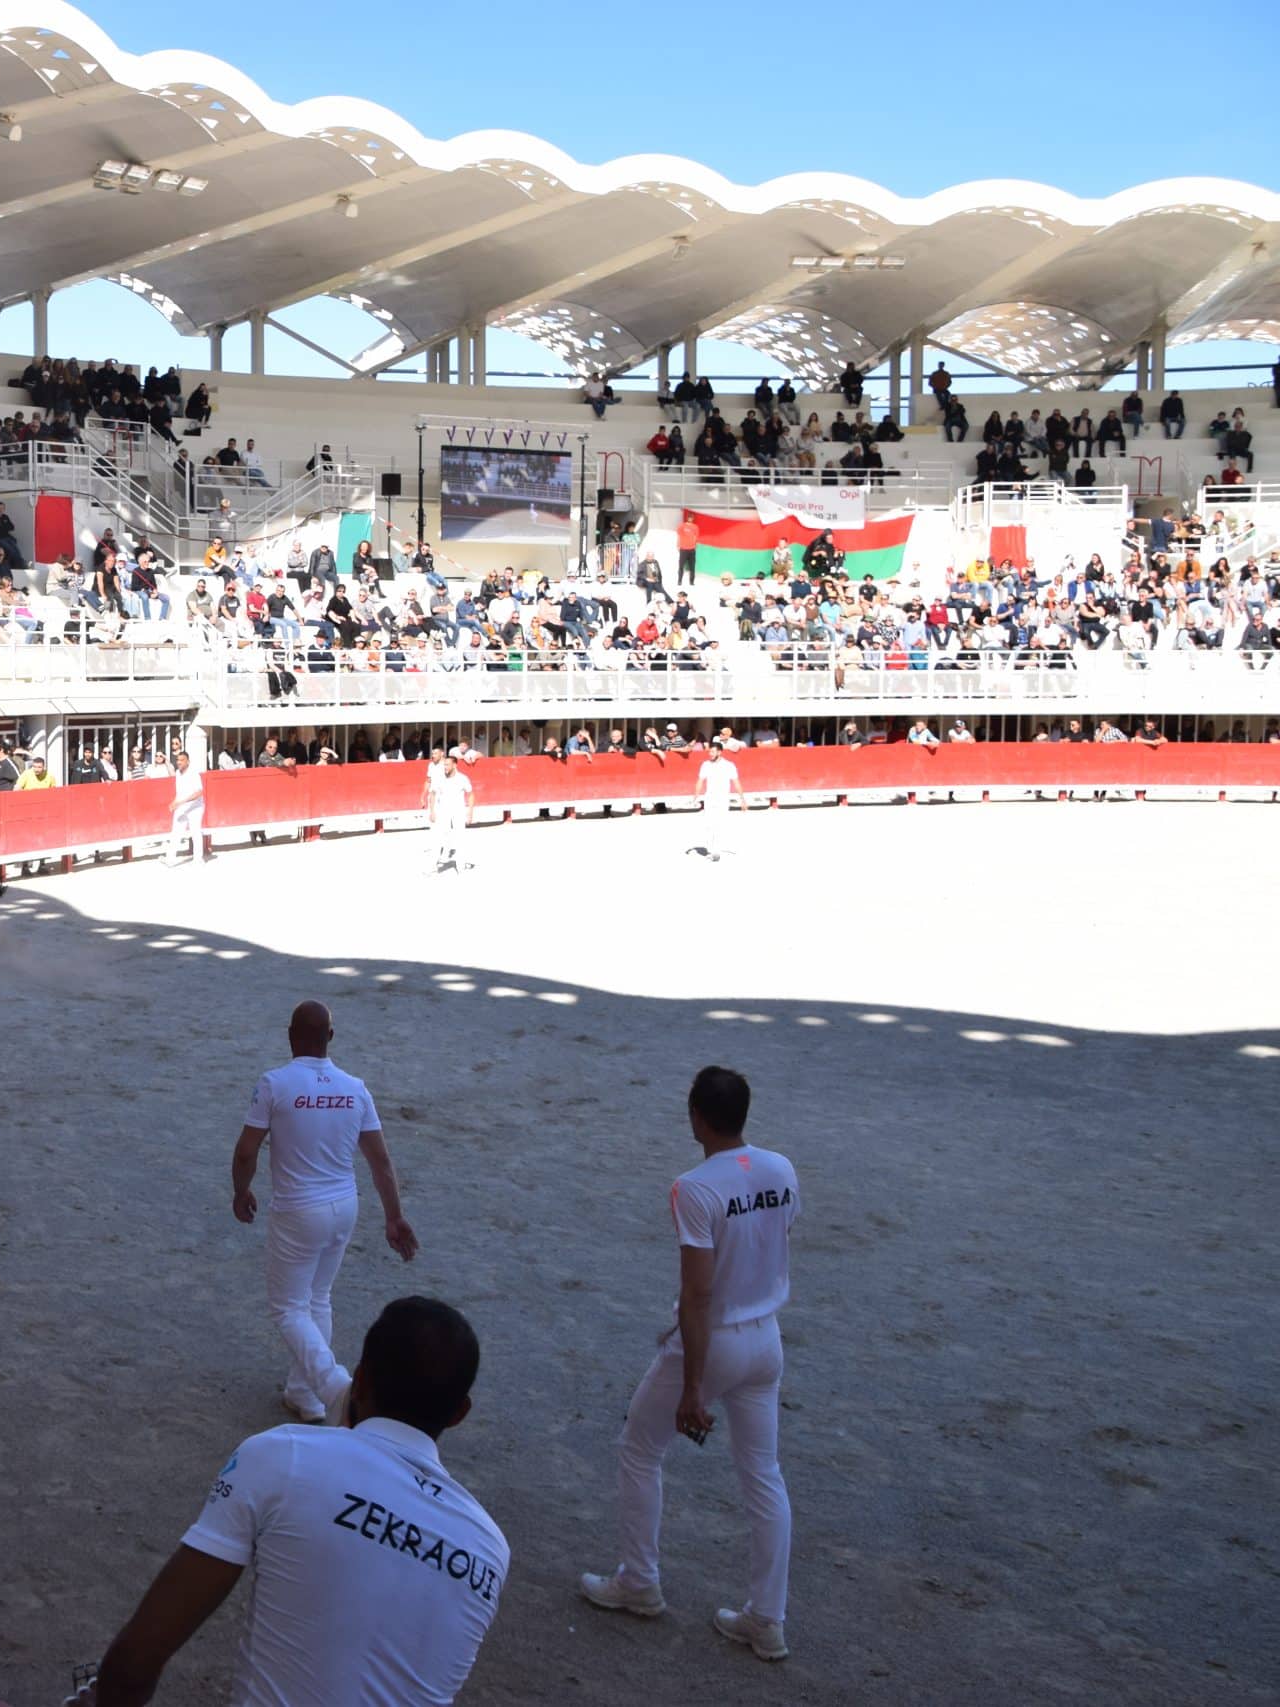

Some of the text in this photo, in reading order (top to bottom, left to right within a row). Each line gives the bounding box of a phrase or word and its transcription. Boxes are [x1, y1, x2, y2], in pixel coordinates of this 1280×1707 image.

[839, 489, 861, 500] Orpi
[808, 503, 824, 511] Pro
[294, 1095, 355, 1109] GLEIZE
[333, 1493, 496, 1601] ZEKRAOUI
